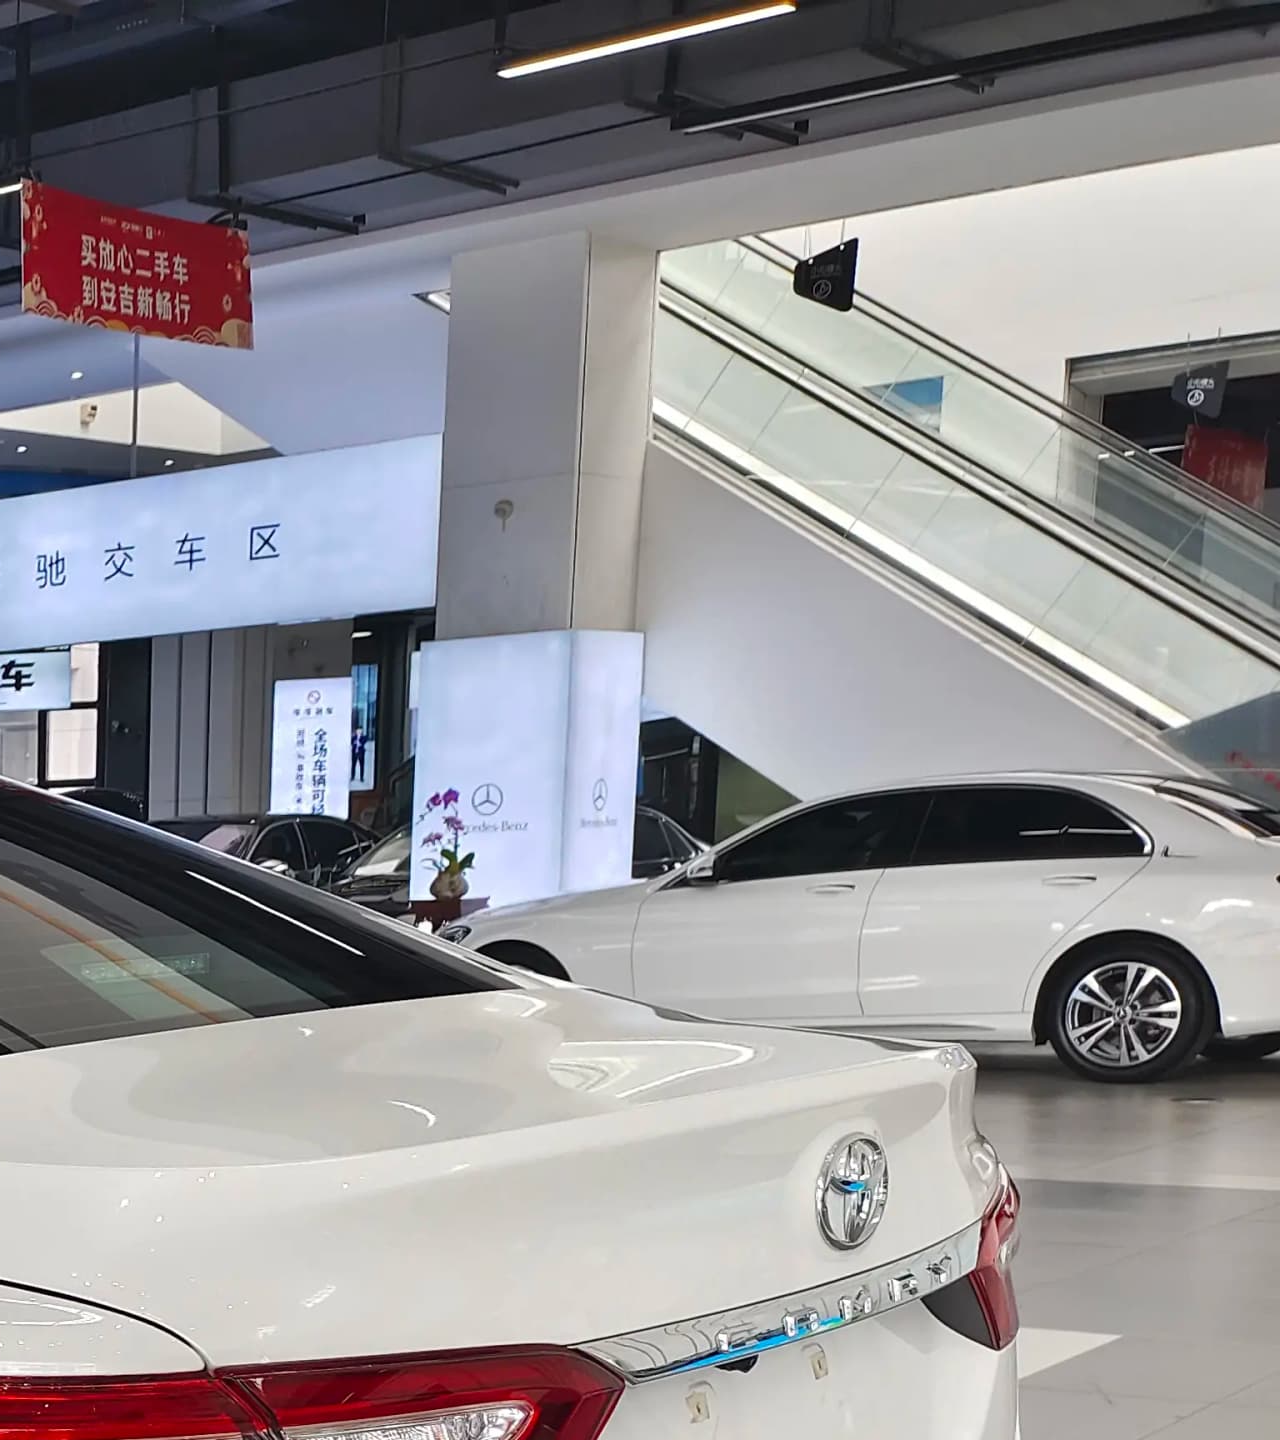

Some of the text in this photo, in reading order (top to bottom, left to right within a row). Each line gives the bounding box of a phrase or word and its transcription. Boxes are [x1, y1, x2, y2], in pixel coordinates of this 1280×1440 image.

[80, 234, 189, 286] 买放心二手车
[82, 276, 191, 325] 到安吉新畅行
